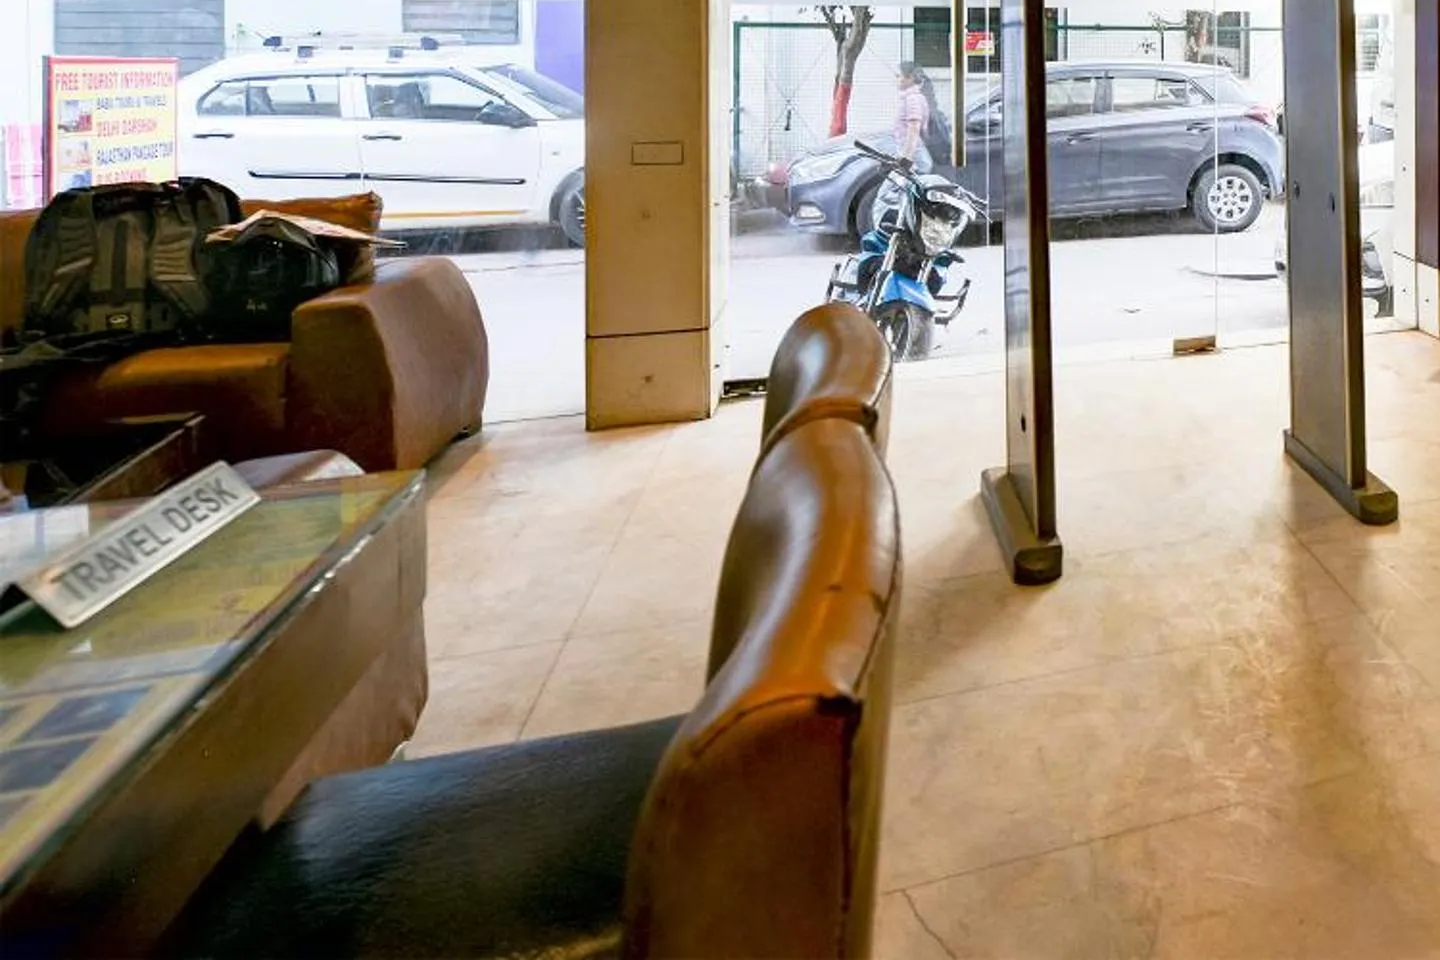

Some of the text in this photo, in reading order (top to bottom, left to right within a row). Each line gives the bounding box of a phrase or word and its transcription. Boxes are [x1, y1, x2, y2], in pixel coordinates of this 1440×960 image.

[55, 72, 79, 91] FREE
[50, 476, 240, 600] TRAVEL DESK
